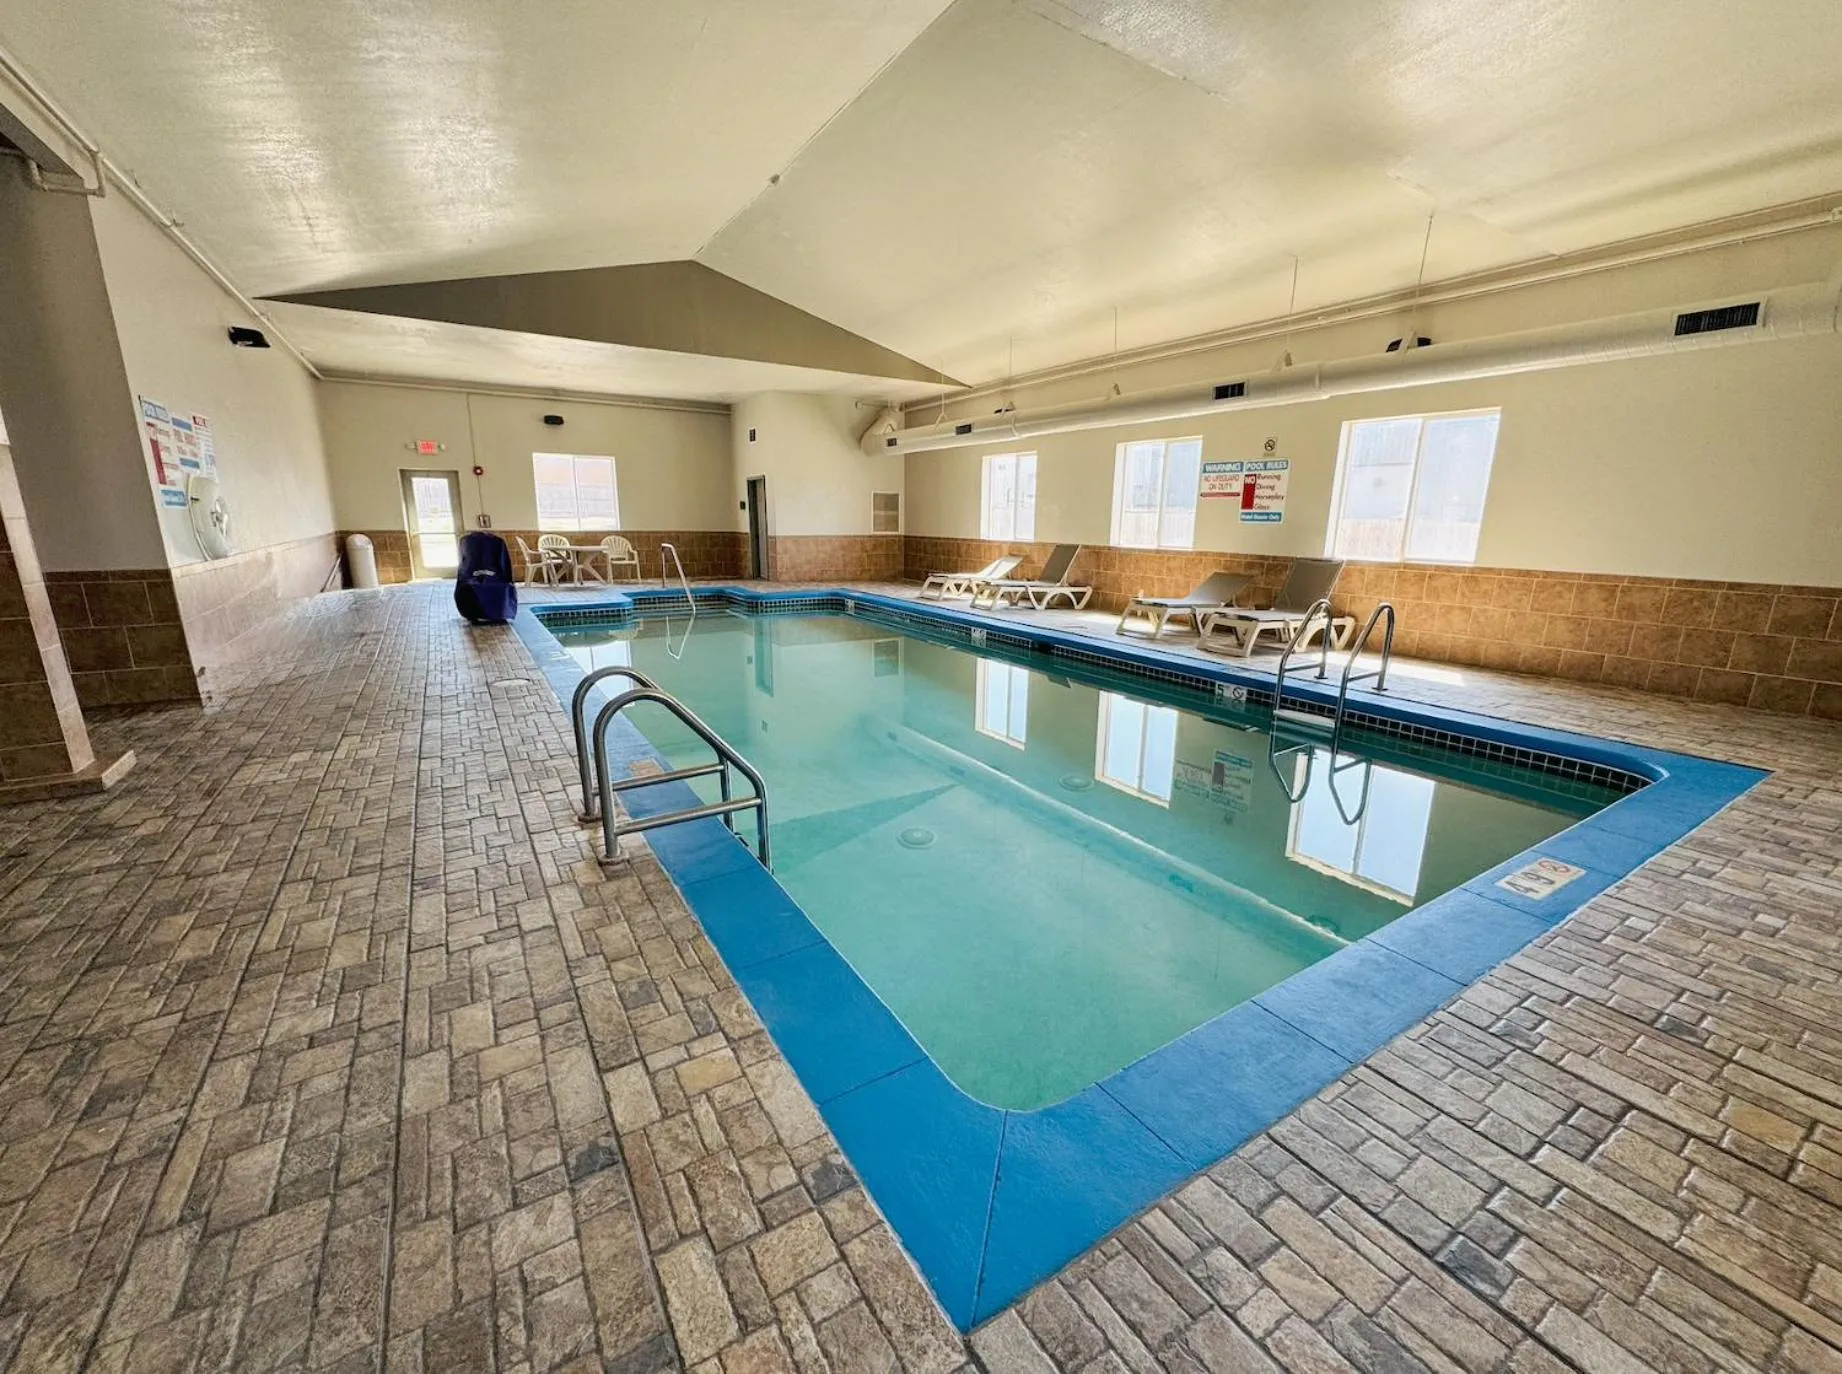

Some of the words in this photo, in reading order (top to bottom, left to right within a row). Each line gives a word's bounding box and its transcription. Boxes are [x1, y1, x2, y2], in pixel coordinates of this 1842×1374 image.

[1205, 462, 1242, 473] WARNING
[1246, 461, 1265, 471] POOL
[1266, 460, 1287, 470] RULES
[1245, 475, 1256, 484] NO
